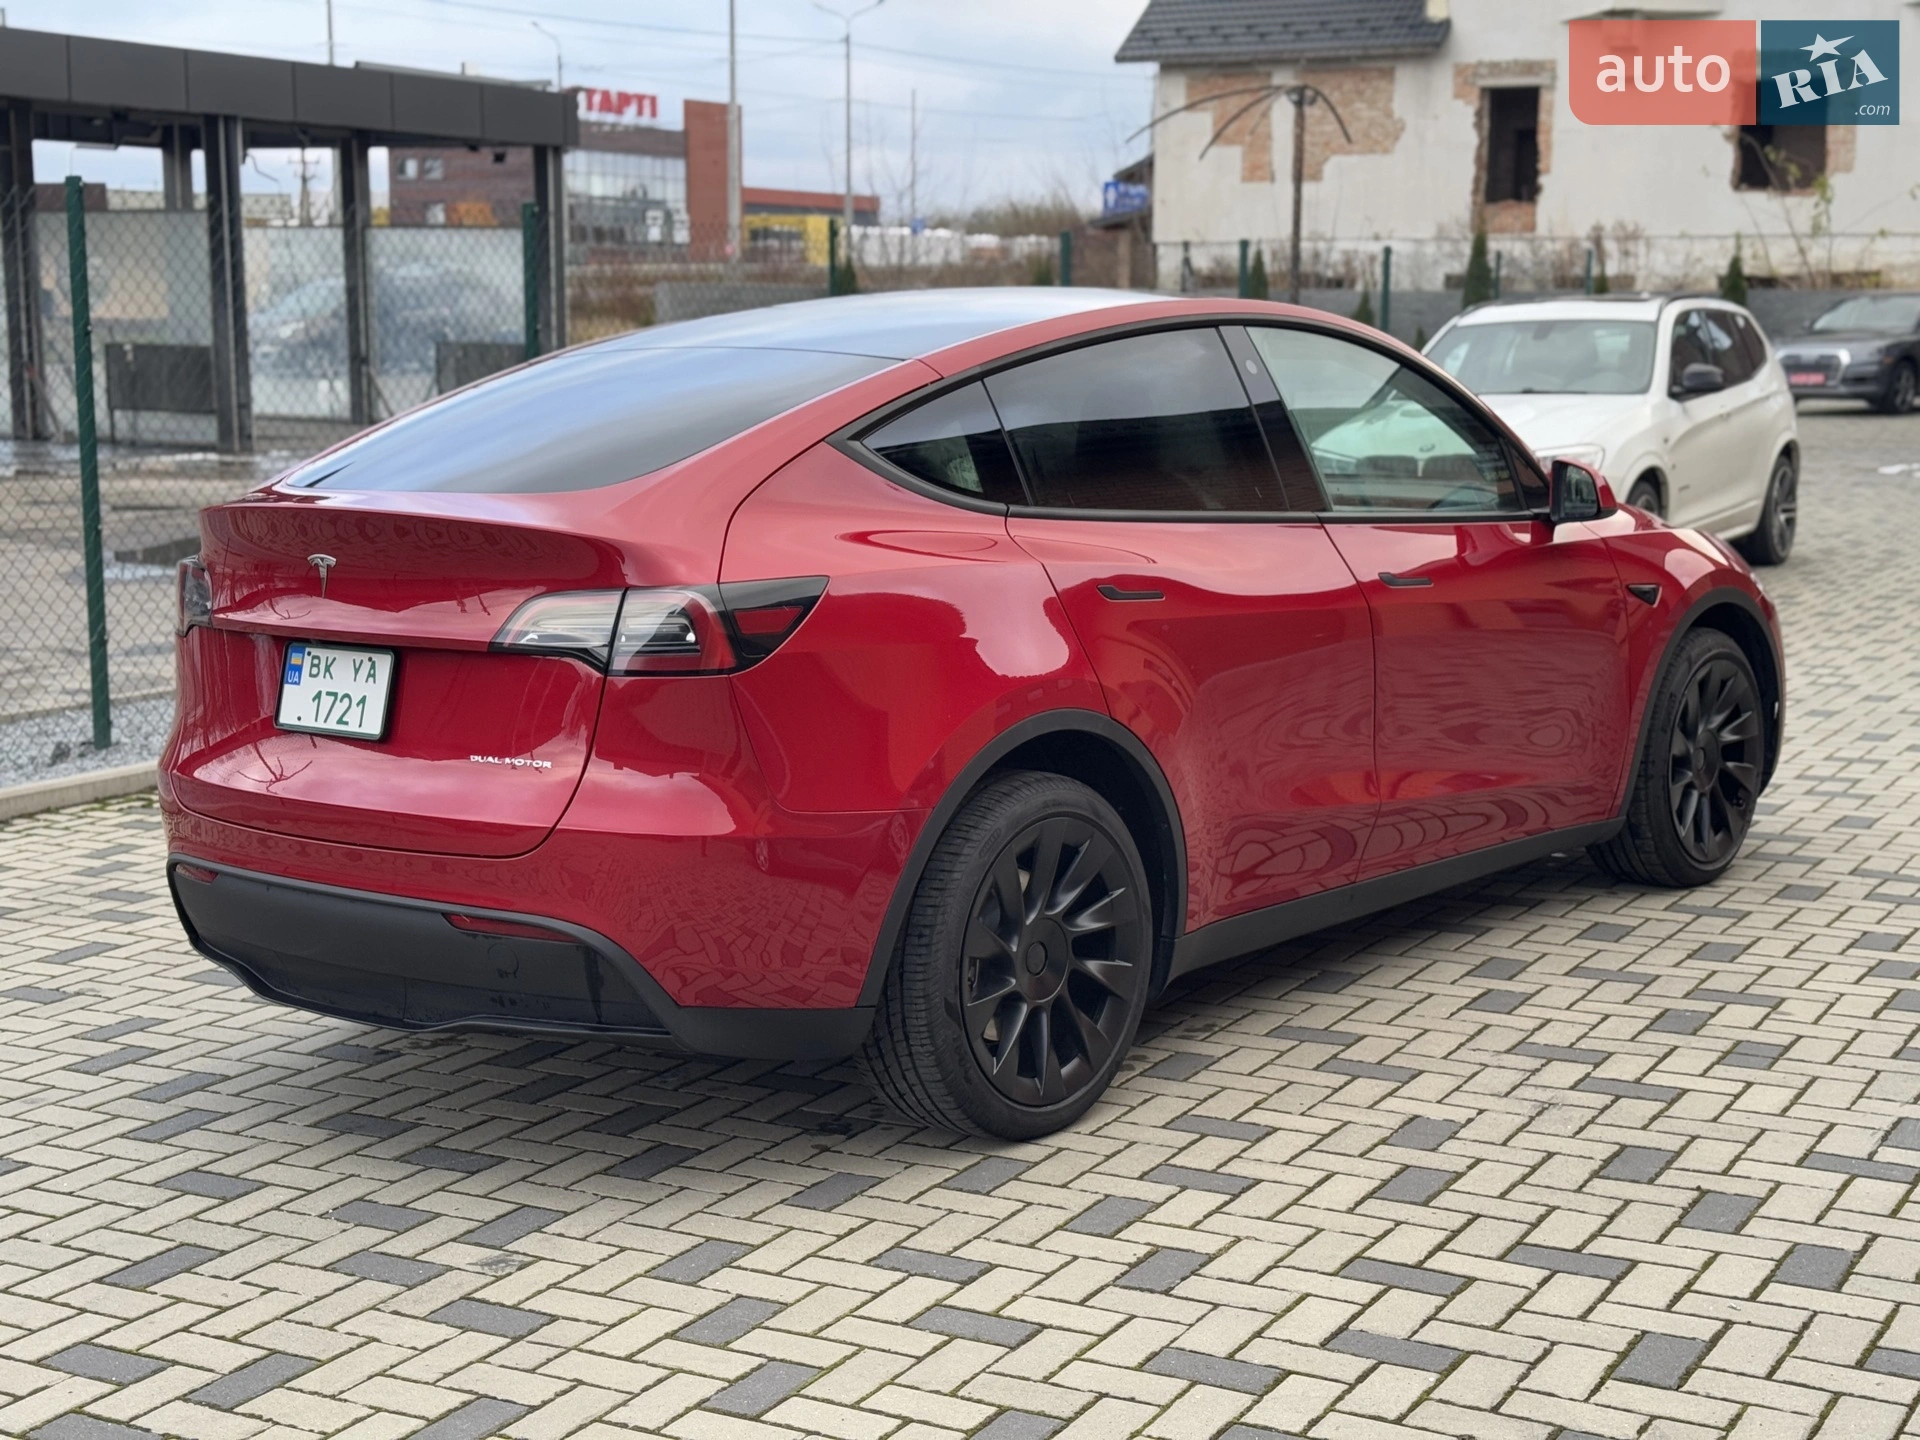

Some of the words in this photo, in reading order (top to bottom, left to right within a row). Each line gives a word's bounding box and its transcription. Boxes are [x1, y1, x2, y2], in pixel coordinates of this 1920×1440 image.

[577, 88, 657, 118] ТАРТІ
[287, 670, 300, 684] UA
[308, 654, 337, 680] BK
[352, 657, 377, 685] YA
[311, 689, 368, 729] 1721
[469, 754, 502, 764] DUAL
[504, 757, 552, 769] MOTOR
